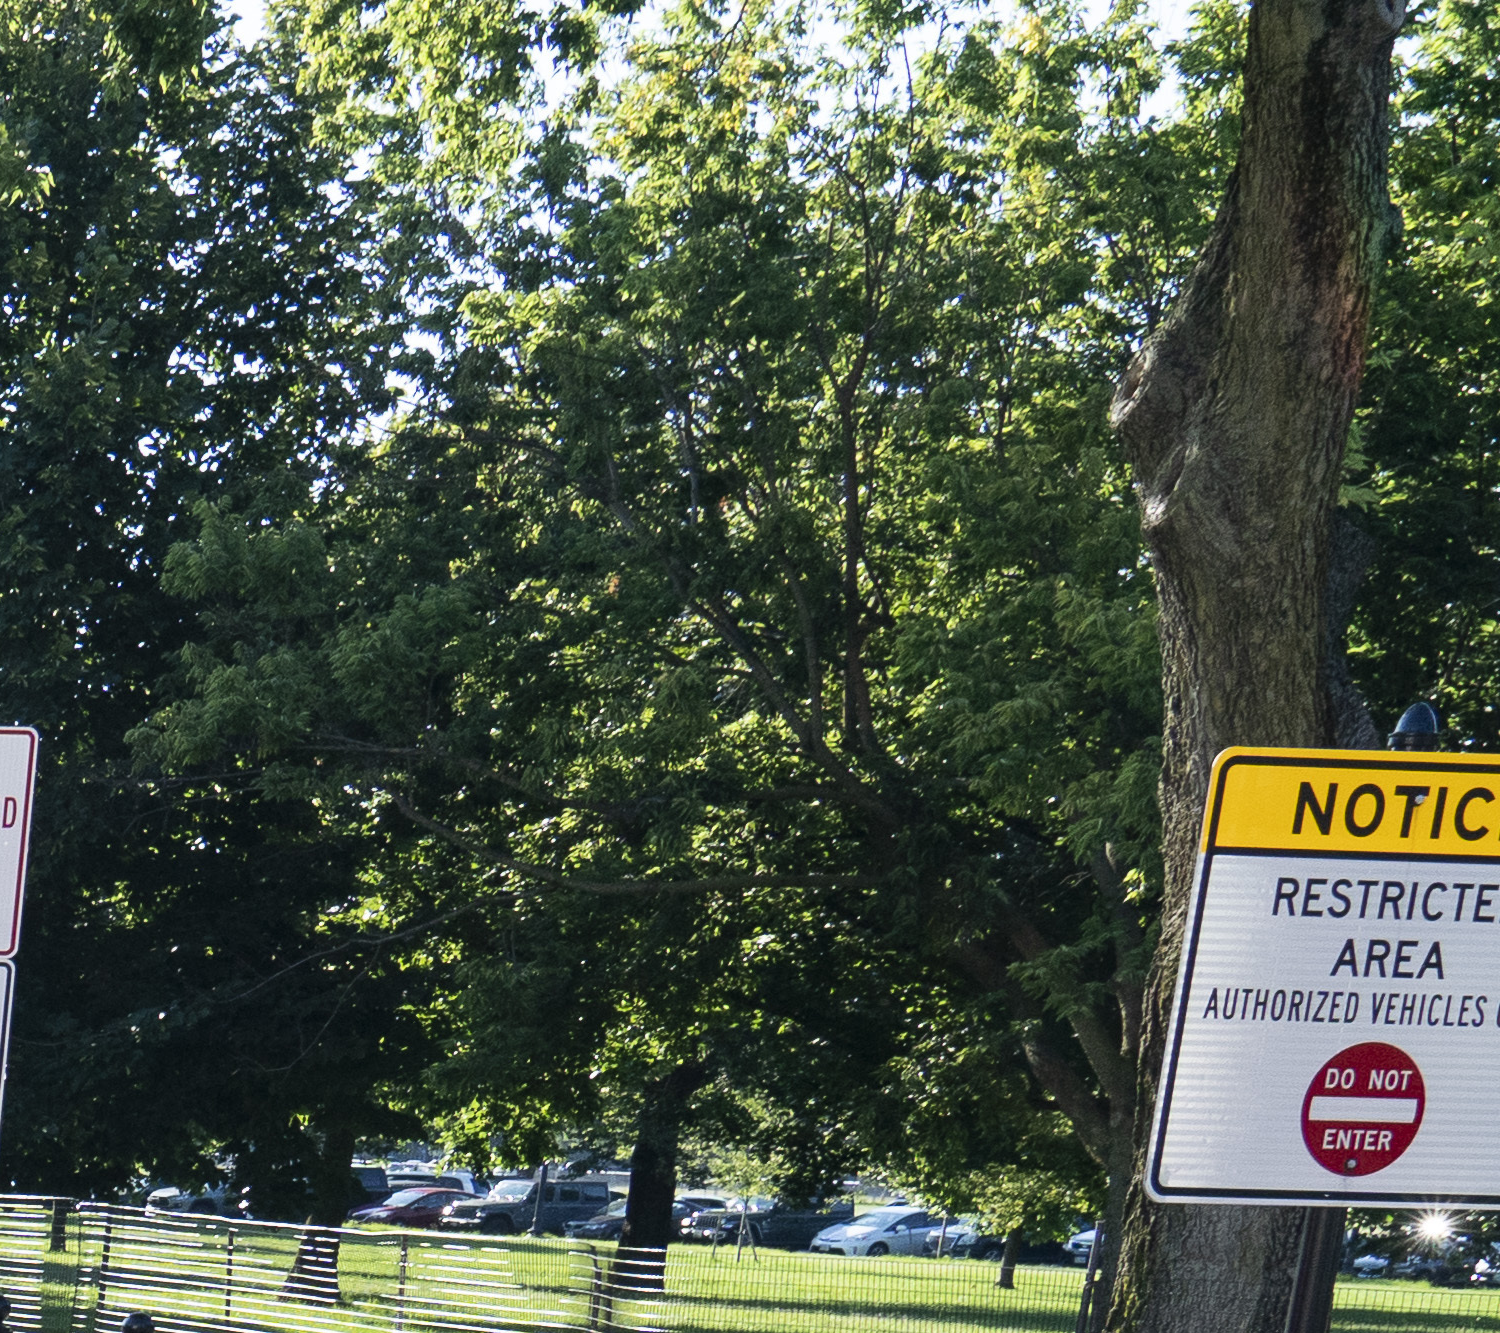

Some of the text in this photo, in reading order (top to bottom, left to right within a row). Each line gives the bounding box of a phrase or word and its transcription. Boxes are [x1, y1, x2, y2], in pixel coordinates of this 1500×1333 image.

[1292, 782, 1500, 841] NOTIC
[1273, 877, 1500, 923] RESTRICTE
[1330, 939, 1445, 979] AREA
[1204, 988, 1358, 1024] AUTHORIZED
[1372, 993, 1488, 1027] VEHICLES
[1325, 1069, 1412, 1091] DO NOT
[1322, 1129, 1393, 1151] ENTER
